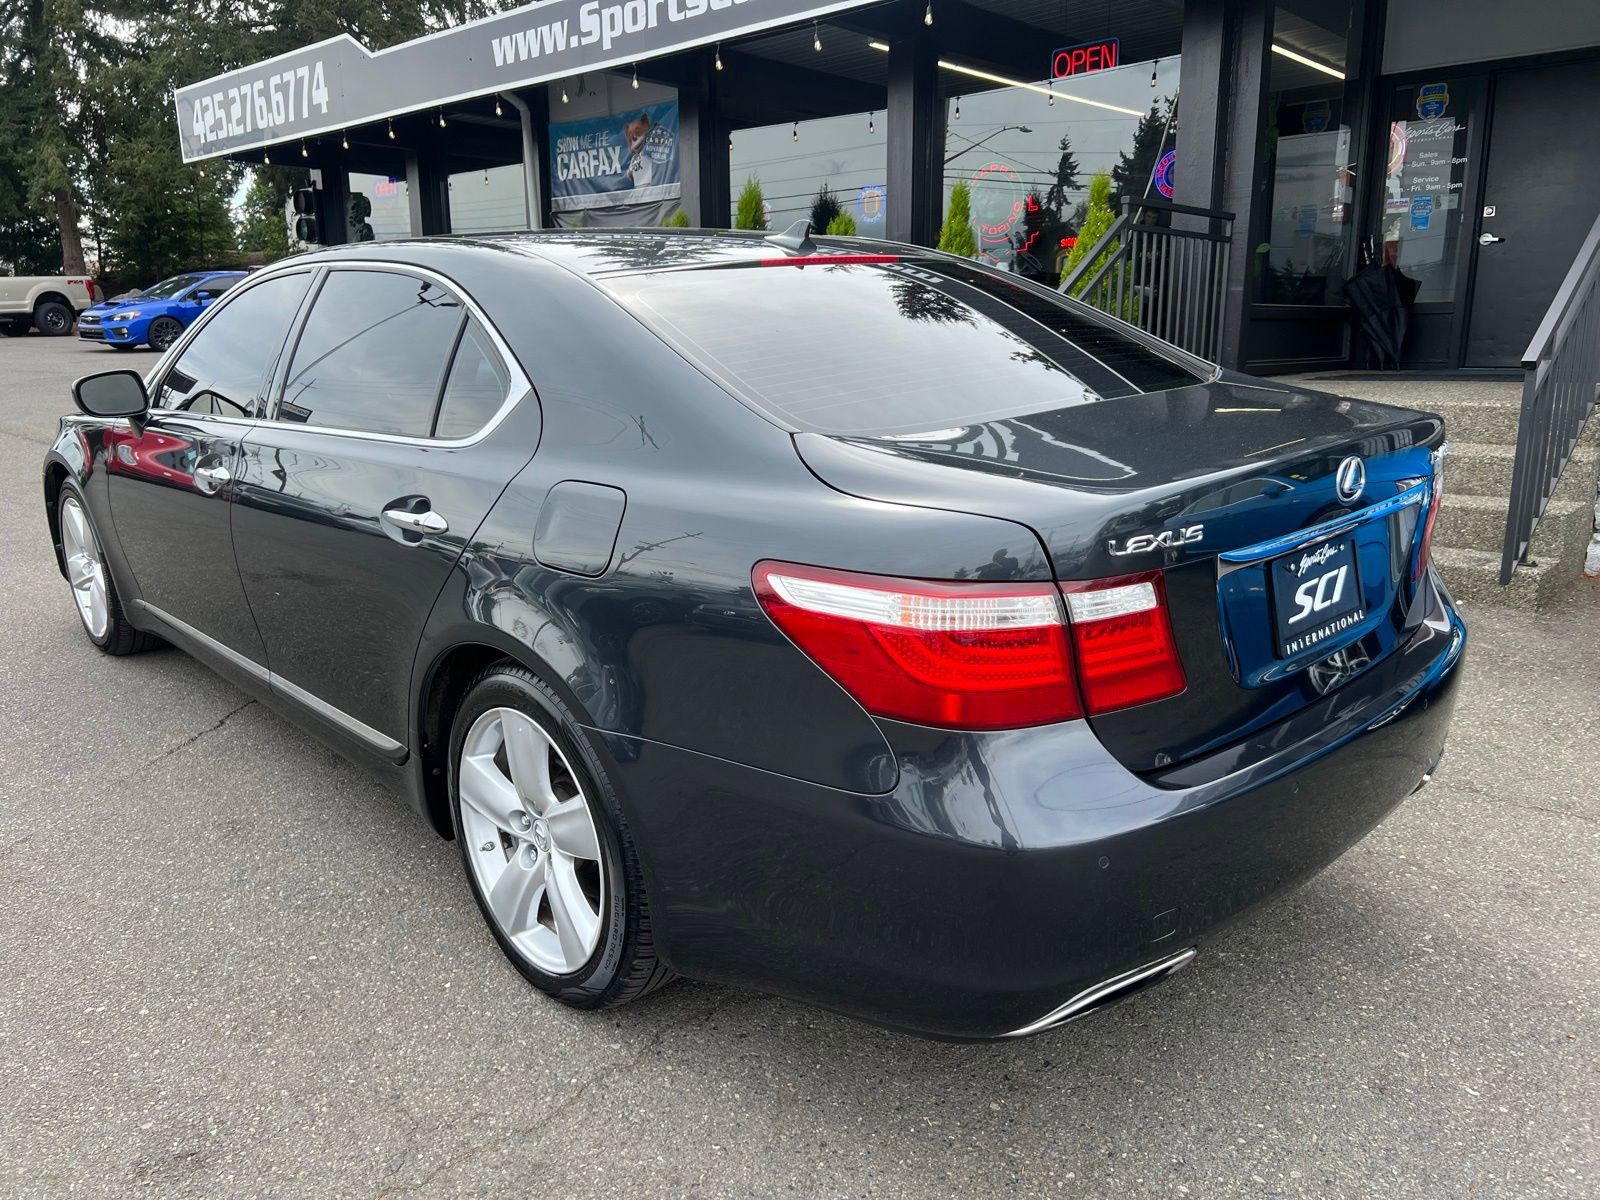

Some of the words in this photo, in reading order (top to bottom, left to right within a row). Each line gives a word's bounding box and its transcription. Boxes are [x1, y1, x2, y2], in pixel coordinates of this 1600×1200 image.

[1054, 43, 1116, 78] OPEN
[193, 61, 328, 143] 425.276.6774
[557, 136, 579, 153] SHOW
[581, 133, 594, 149] ME
[595, 130, 609, 148] THE
[557, 145, 622, 181] CARFAX
[1412, 176, 1439, 184] Service
[1426, 183, 1440, 191] 9am
[1447, 182, 1463, 190] 5pm
[1108, 524, 1204, 557] LEXUS
[1288, 564, 1348, 624] SCI
[1286, 609, 1365, 656] INTERNATIONAL
